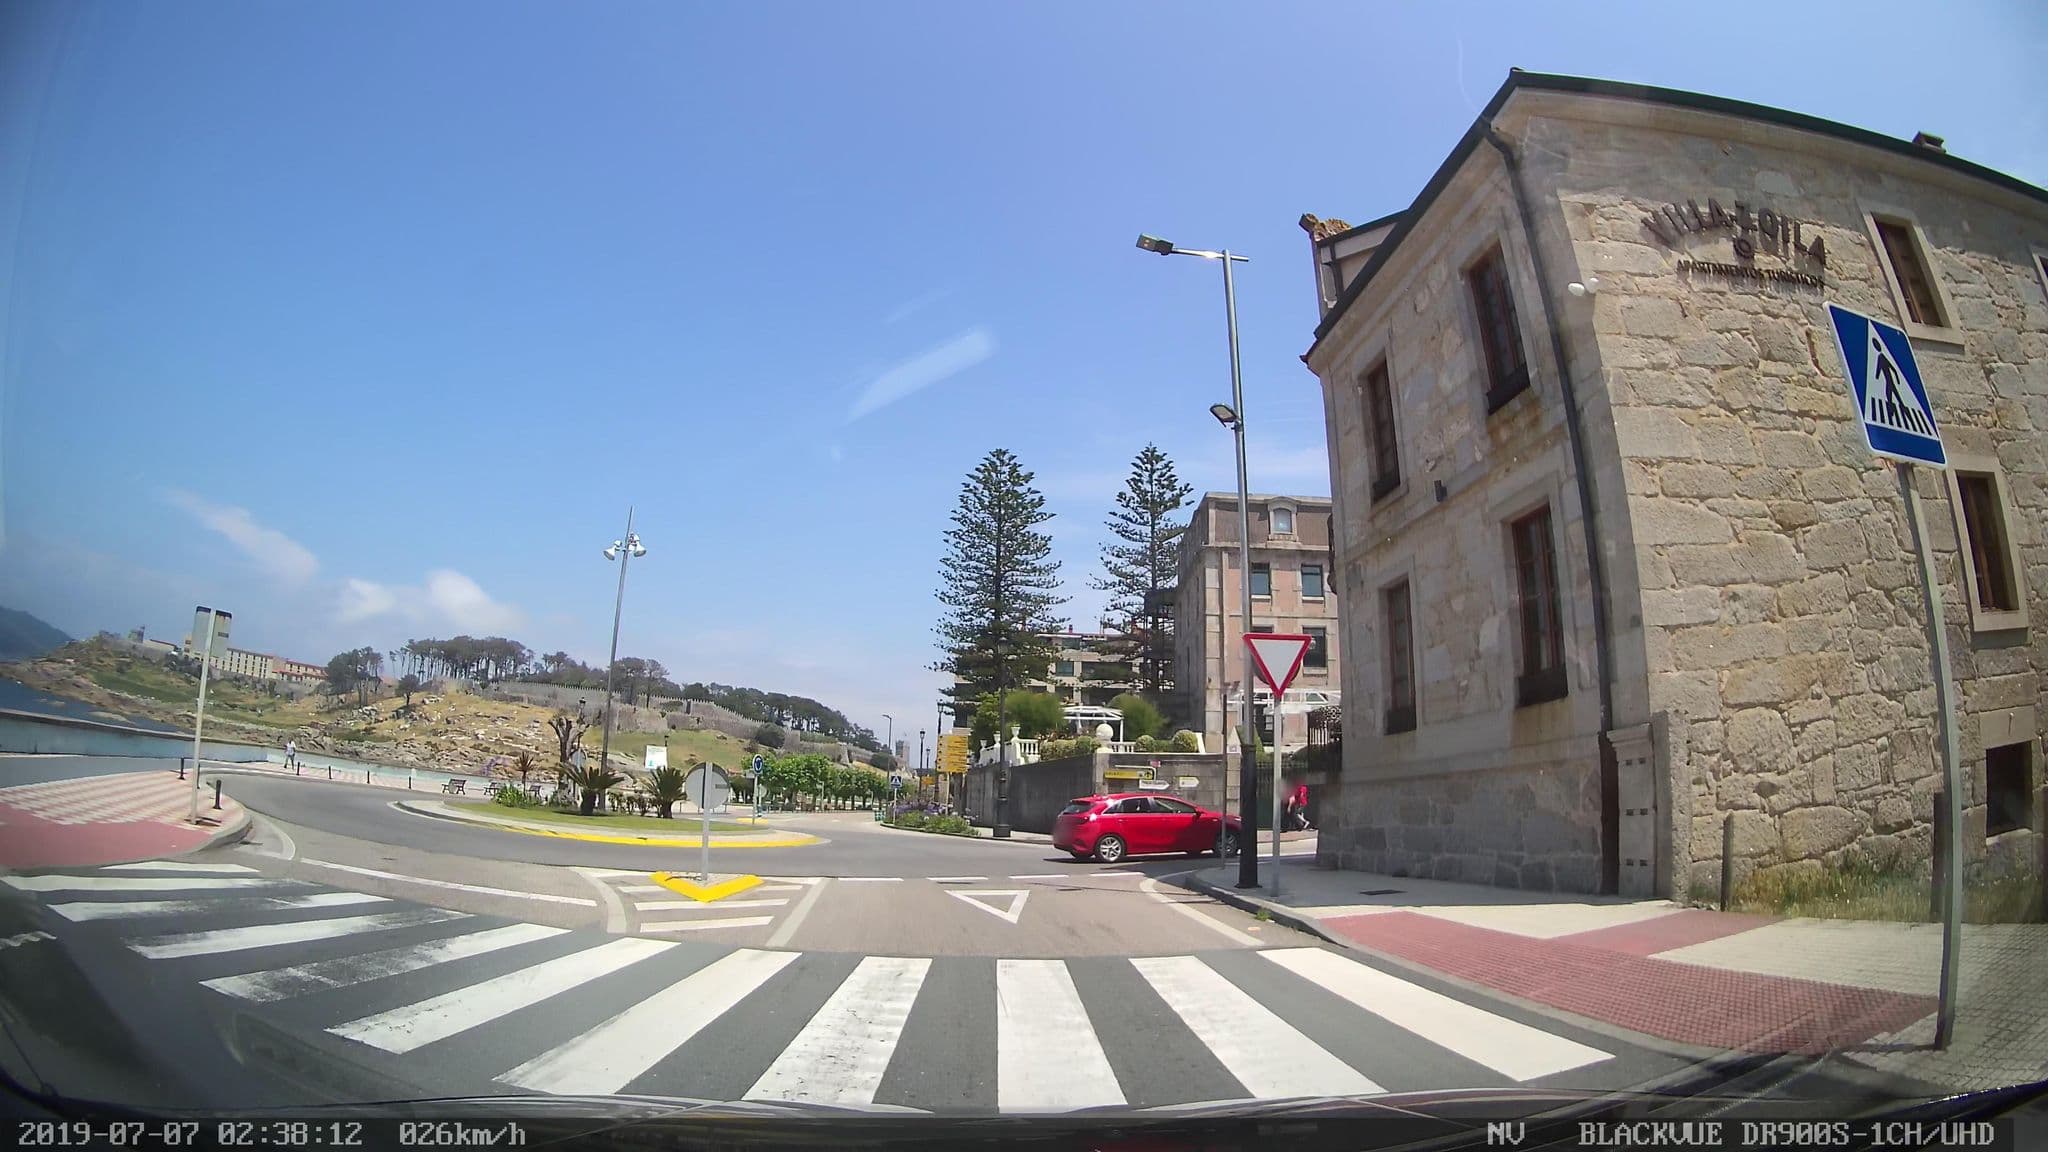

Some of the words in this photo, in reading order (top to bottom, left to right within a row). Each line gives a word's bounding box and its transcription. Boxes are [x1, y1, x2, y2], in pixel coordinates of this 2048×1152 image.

[1640, 198, 1735, 248] VILLA
[1729, 199, 1827, 266] ZOILA
[1676, 259, 1764, 279] APARTAMENTOS
